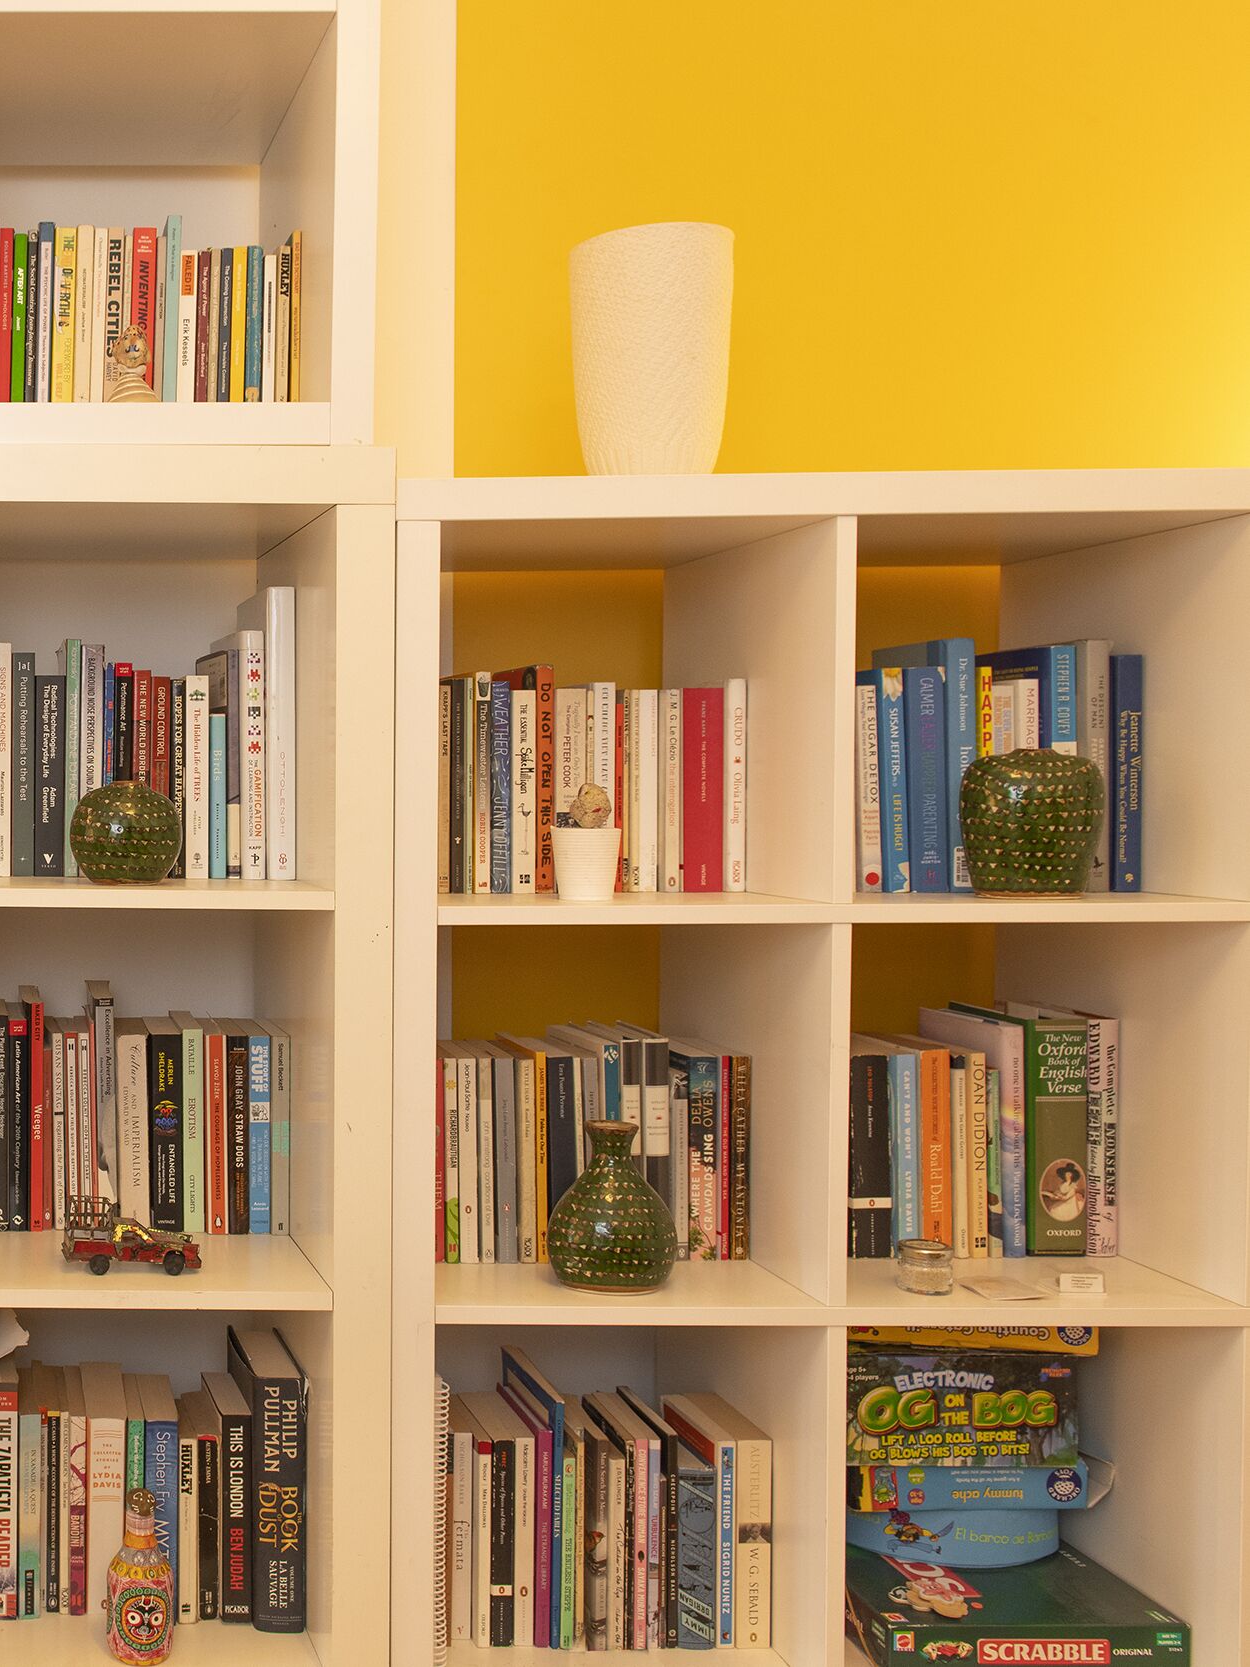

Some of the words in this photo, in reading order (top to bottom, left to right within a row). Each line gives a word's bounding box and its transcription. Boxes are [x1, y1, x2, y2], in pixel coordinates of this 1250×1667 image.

[108, 239, 121, 297] REBEL
[183, 255, 193, 283] FAILED
[280, 253, 290, 296] HUXLEY
[183, 283, 193, 296] IT!
[182, 318, 191, 335] Erik
[181, 337, 190, 366] Kessels
[18, 676, 28, 707] Putting
[540, 683, 552, 701] DO
[19, 709, 29, 753] Rehearsals
[541, 711, 552, 741] NOT
[734, 707, 743, 746] CRUDO
[1129, 711, 1141, 752] Jeanette
[19, 755, 28, 765] to
[19, 766, 29, 781] the
[541, 751, 552, 788] OPEN
[19, 783, 28, 801] Test
[49, 786, 57, 808] Adam
[1130, 756, 1141, 811] Winterson
[42, 786, 50, 823] Greenfield
[253, 769, 262, 838] GAMIFICATION
[541, 798, 552, 826] THIS
[541, 831, 552, 867] SIDE
[158, 1052, 166, 1092] SHELDRAKE
[251, 1045, 262, 1093] STUFF
[277, 1043, 285, 1066] Samuel
[235, 1065, 244, 1086] JOHN
[737, 1065, 746, 1102] WILLA
[973, 1060, 984, 1105] JOAN
[235, 1087, 244, 1111] GRAY
[32, 1104, 43, 1140] Weegee
[235, 1113, 244, 1141] STRAW
[736, 1107, 746, 1153] CATHER
[235, 1144, 244, 1168] DOGS
[973, 1112, 986, 1172] DIDION
[929, 1144, 941, 1179] Roald
[930, 1184, 942, 1214] Dahl
[1047, 1229, 1082, 1237] OXFORD
[894, 1369, 995, 1392] ELECTRONIC
[858, 1386, 937, 1434] OG
[944, 1394, 965, 1408] ON
[972, 1390, 1058, 1429] BOG
[263, 1386, 280, 1472] PULLMAN
[282, 1400, 297, 1459] PHILIP
[941, 1412, 969, 1427] THE
[230, 1426, 244, 1451] THIS
[181, 1444, 192, 1495] HUXLEY
[230, 1457, 244, 1468] IS
[230, 1470, 244, 1518] LONDON
[723, 1474, 731, 1493] THE
[258, 1490, 277, 1547] DUST
[280, 1486, 298, 1553] BOOK
[723, 1495, 731, 1529] FRIEND
[230, 1528, 244, 1551] BEN
[230, 1553, 244, 1590] JUDAH
[722, 1541, 731, 1577] SIGRID
[722, 1579, 731, 1614] NUNEZ
[748, 1583, 759, 1626] SEBALD
[983, 1643, 1107, 1662] SCRABBLE
[1113, 1647, 1153, 1656] ORIGINAL
